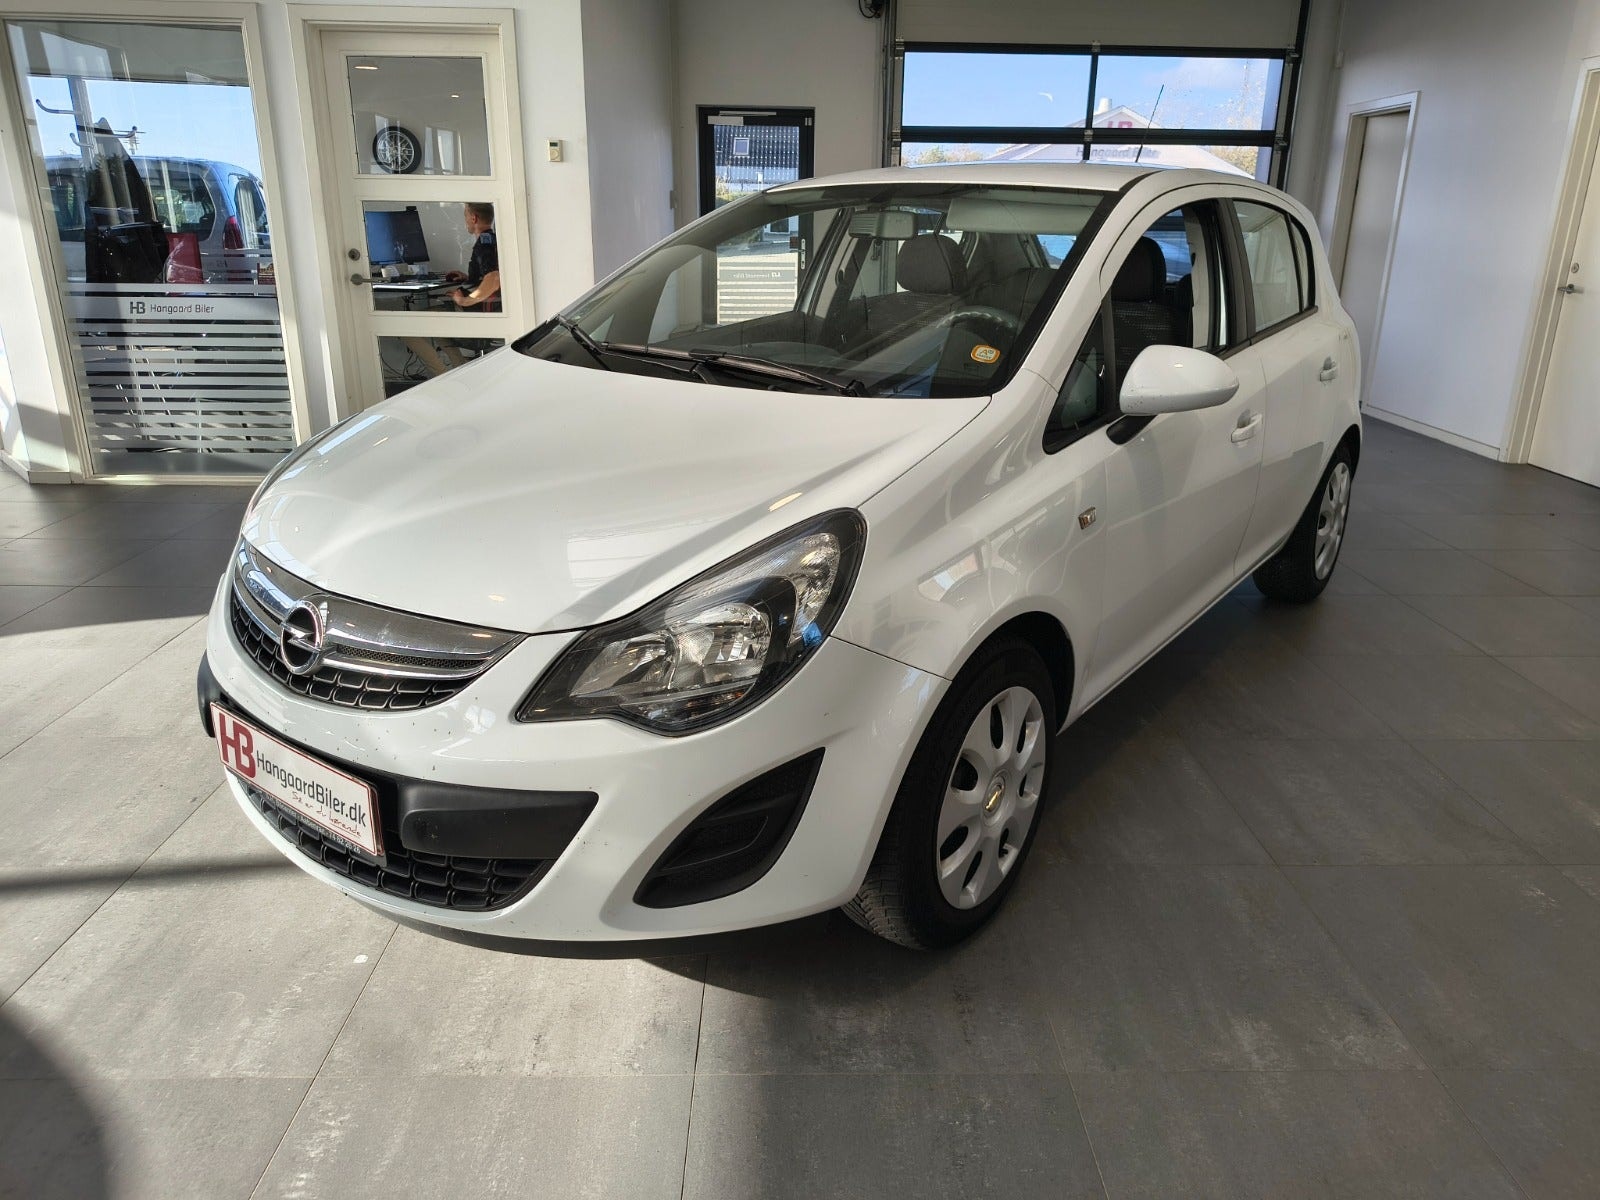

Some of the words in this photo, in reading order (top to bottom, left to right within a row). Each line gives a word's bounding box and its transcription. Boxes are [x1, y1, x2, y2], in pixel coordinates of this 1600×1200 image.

[1075, 146, 1130, 159] Hngaard
[129, 301, 146, 314] HB
[150, 303, 192, 314] Hangaard
[195, 304, 215, 313] Biler
[219, 712, 256, 779] HB
[256, 750, 366, 827] HangaardBiler.dk
